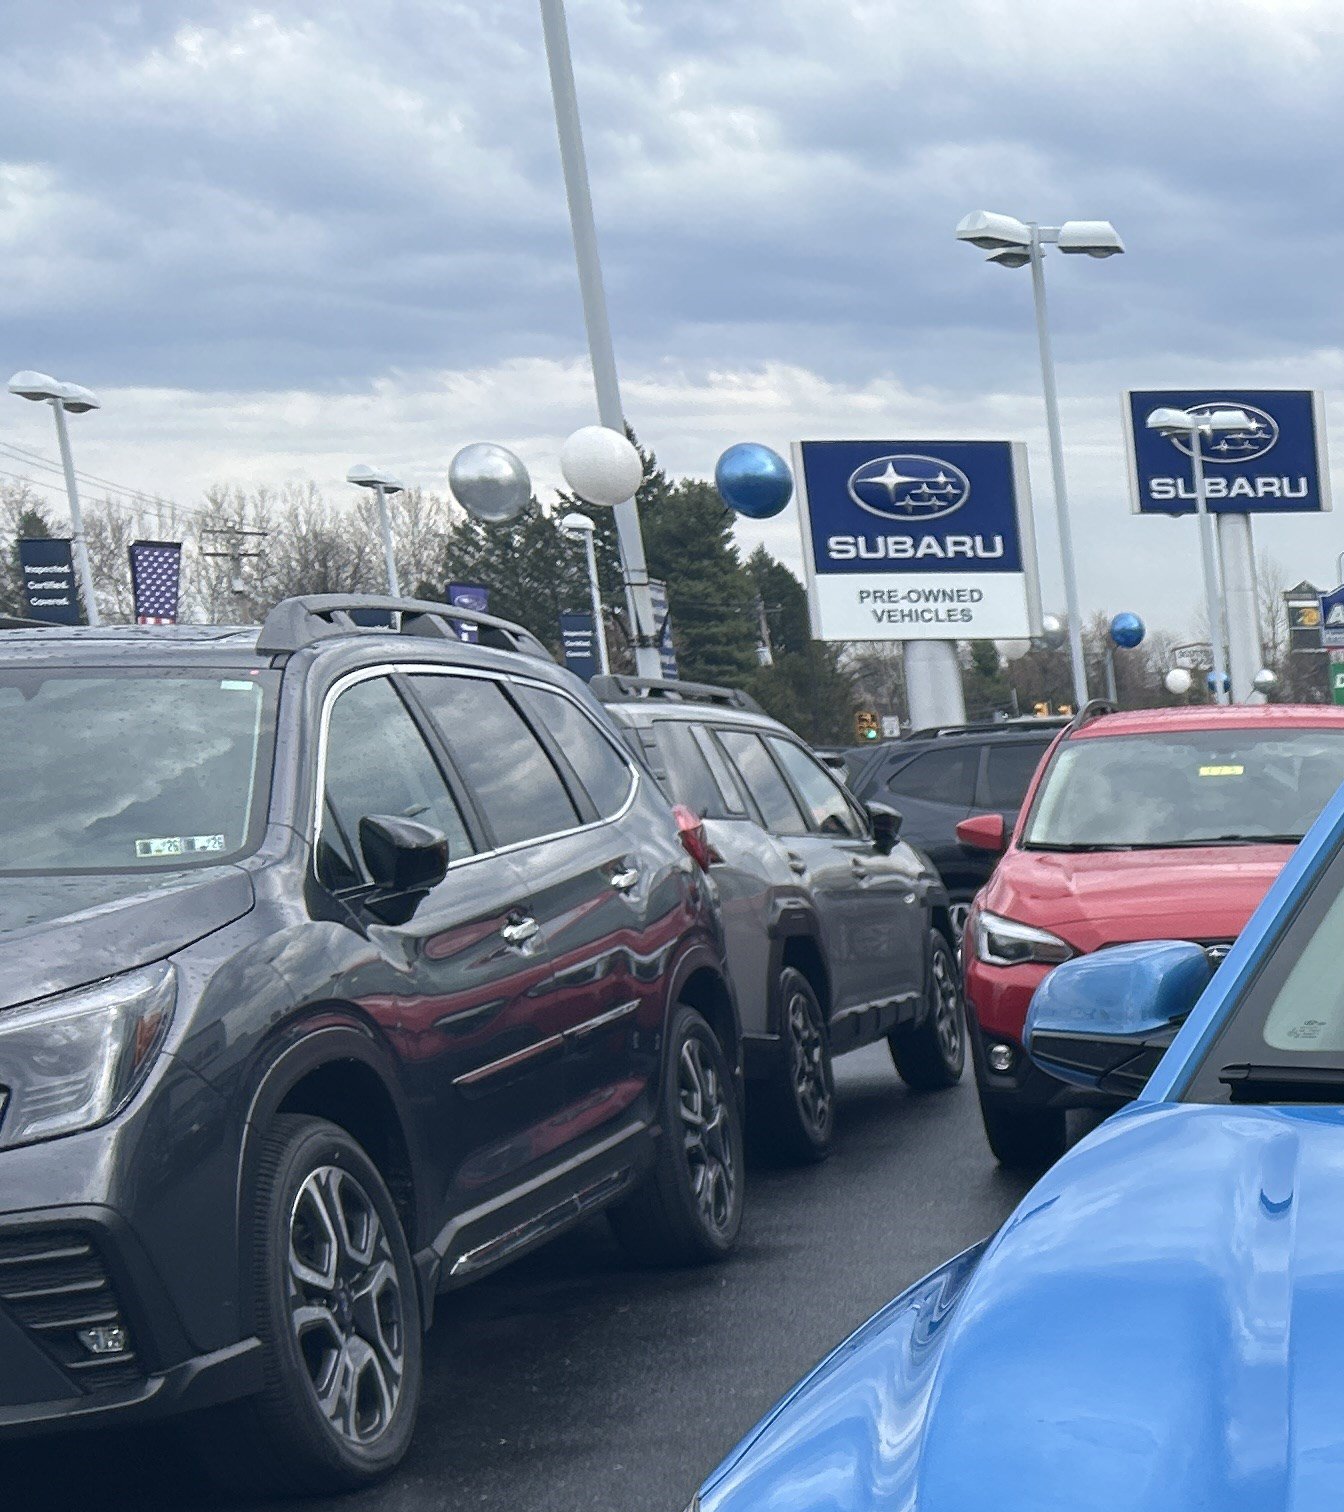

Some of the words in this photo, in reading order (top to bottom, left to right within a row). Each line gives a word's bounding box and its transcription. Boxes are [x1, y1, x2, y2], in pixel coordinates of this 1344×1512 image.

[1149, 476, 1309, 499] SUBARU
[827, 534, 1005, 560] SUBARU
[858, 588, 983, 605] PRE-OWNED
[871, 608, 974, 624] VEHICLES
